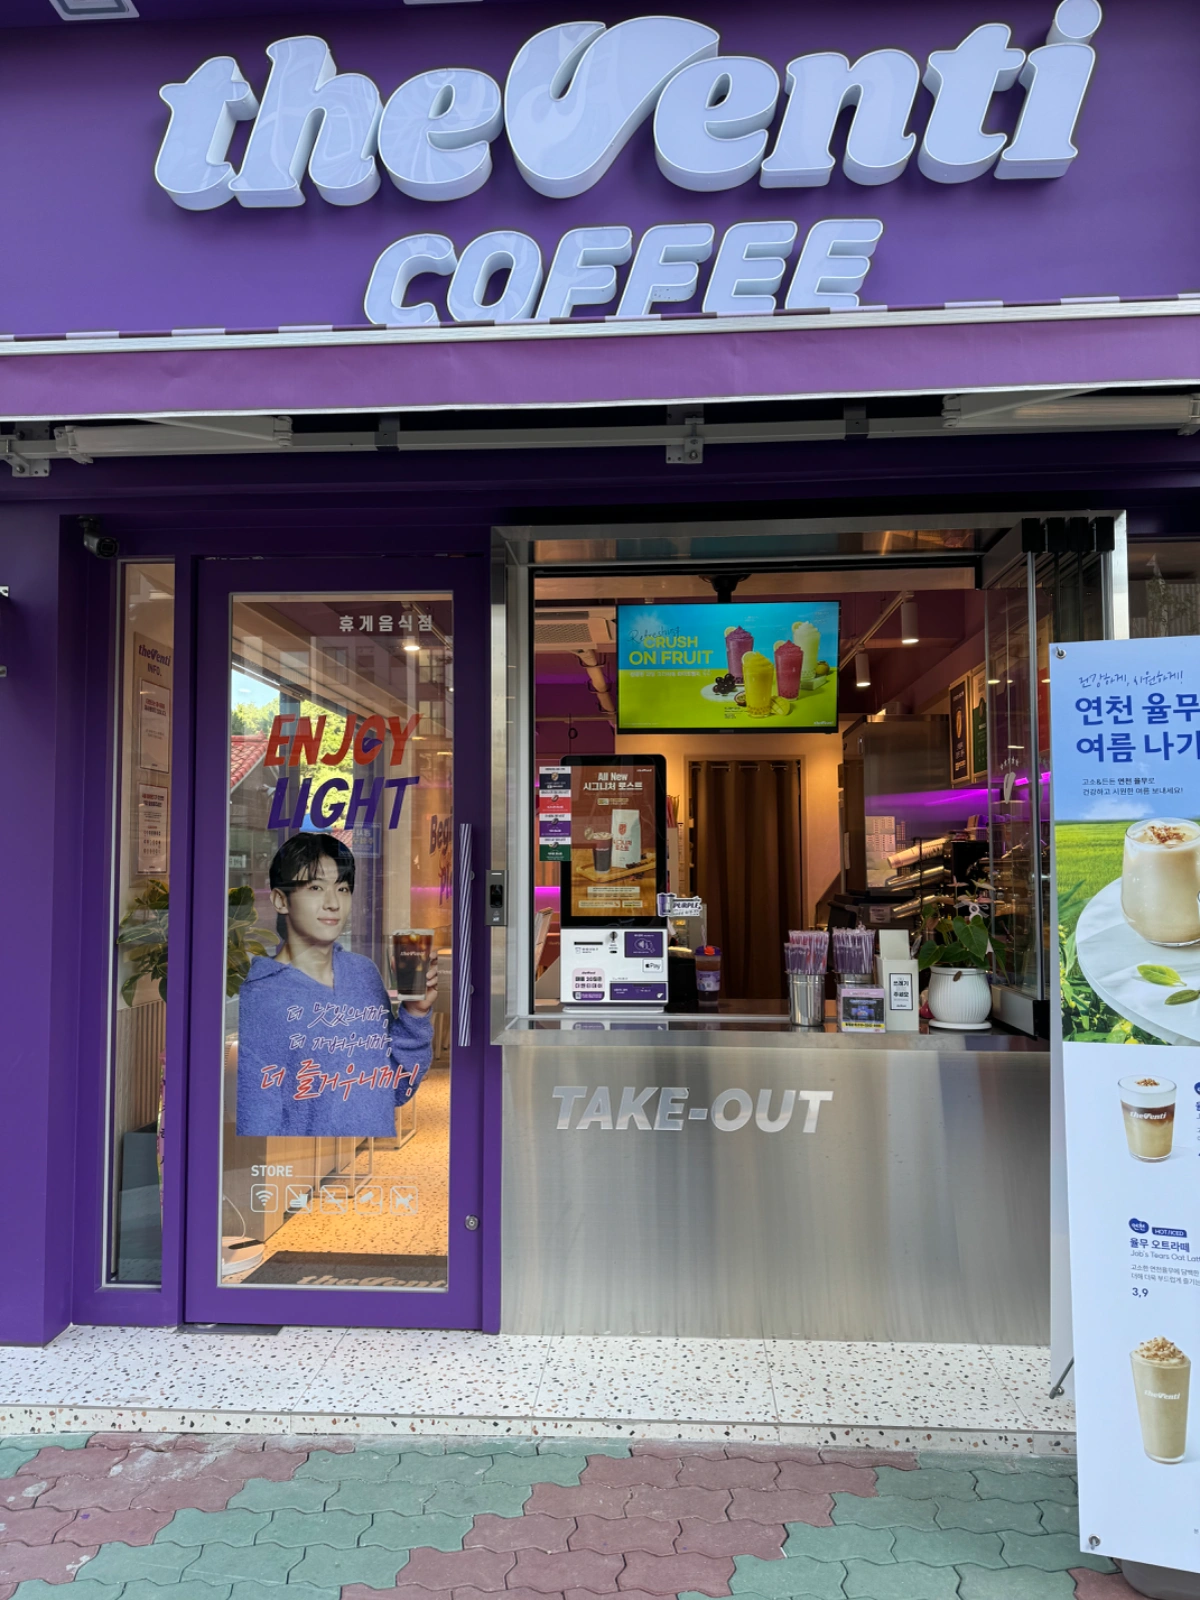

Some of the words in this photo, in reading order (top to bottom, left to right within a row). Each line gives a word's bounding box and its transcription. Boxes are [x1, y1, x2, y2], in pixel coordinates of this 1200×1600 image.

[152, 0, 1103, 211] theVenti
[363, 218, 883, 327] COFFEE
[339, 614, 433, 632] 휴게음식점
[643, 636, 698, 649] CRUSH
[629, 650, 657, 665] ON
[661, 649, 714, 665] FRUIT
[1075, 695, 1134, 725] 연천
[1142, 693, 1200, 725] 율무
[264, 713, 424, 767] ENJOY
[1076, 732, 1136, 762] 여름
[1144, 730, 1200, 761] 나기
[267, 776, 420, 830] LIGHT
[287, 1004, 305, 1022] 더
[289, 1032, 307, 1050] 더
[260, 1064, 286, 1089] 더
[293, 1058, 420, 1101] 즐거우니까!
[552, 1086, 834, 1133] TAKE-OUT
[1130, 1111, 1167, 1120] theVenti
[251, 1165, 293, 1177] STORE
[1130, 1237, 1149, 1249] 율무
[1151, 1239, 1190, 1253] 오트라떼
[1130, 1250, 1149, 1258] Job's
[1150, 1251, 1170, 1260] Tears
[1171, 1253, 1185, 1261] Oat
